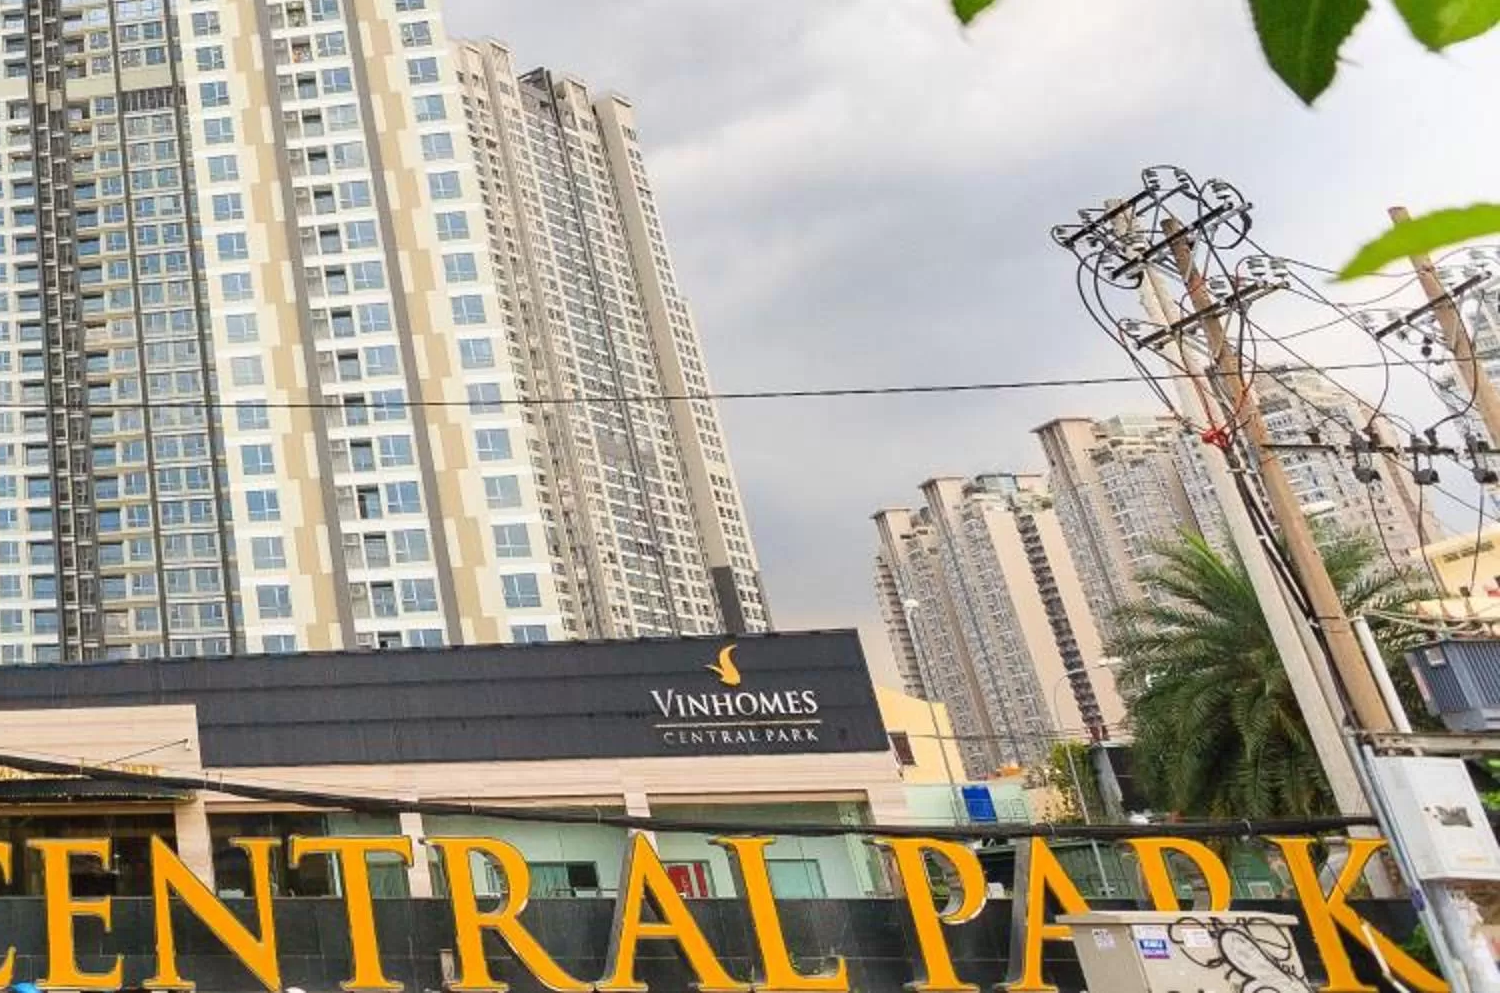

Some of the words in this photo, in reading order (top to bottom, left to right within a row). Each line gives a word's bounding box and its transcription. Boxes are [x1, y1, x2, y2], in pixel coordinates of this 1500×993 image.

[651, 689, 819, 718] VINHOMES
[663, 730, 759, 745] CENTRAL
[766, 728, 820, 743] PARK
